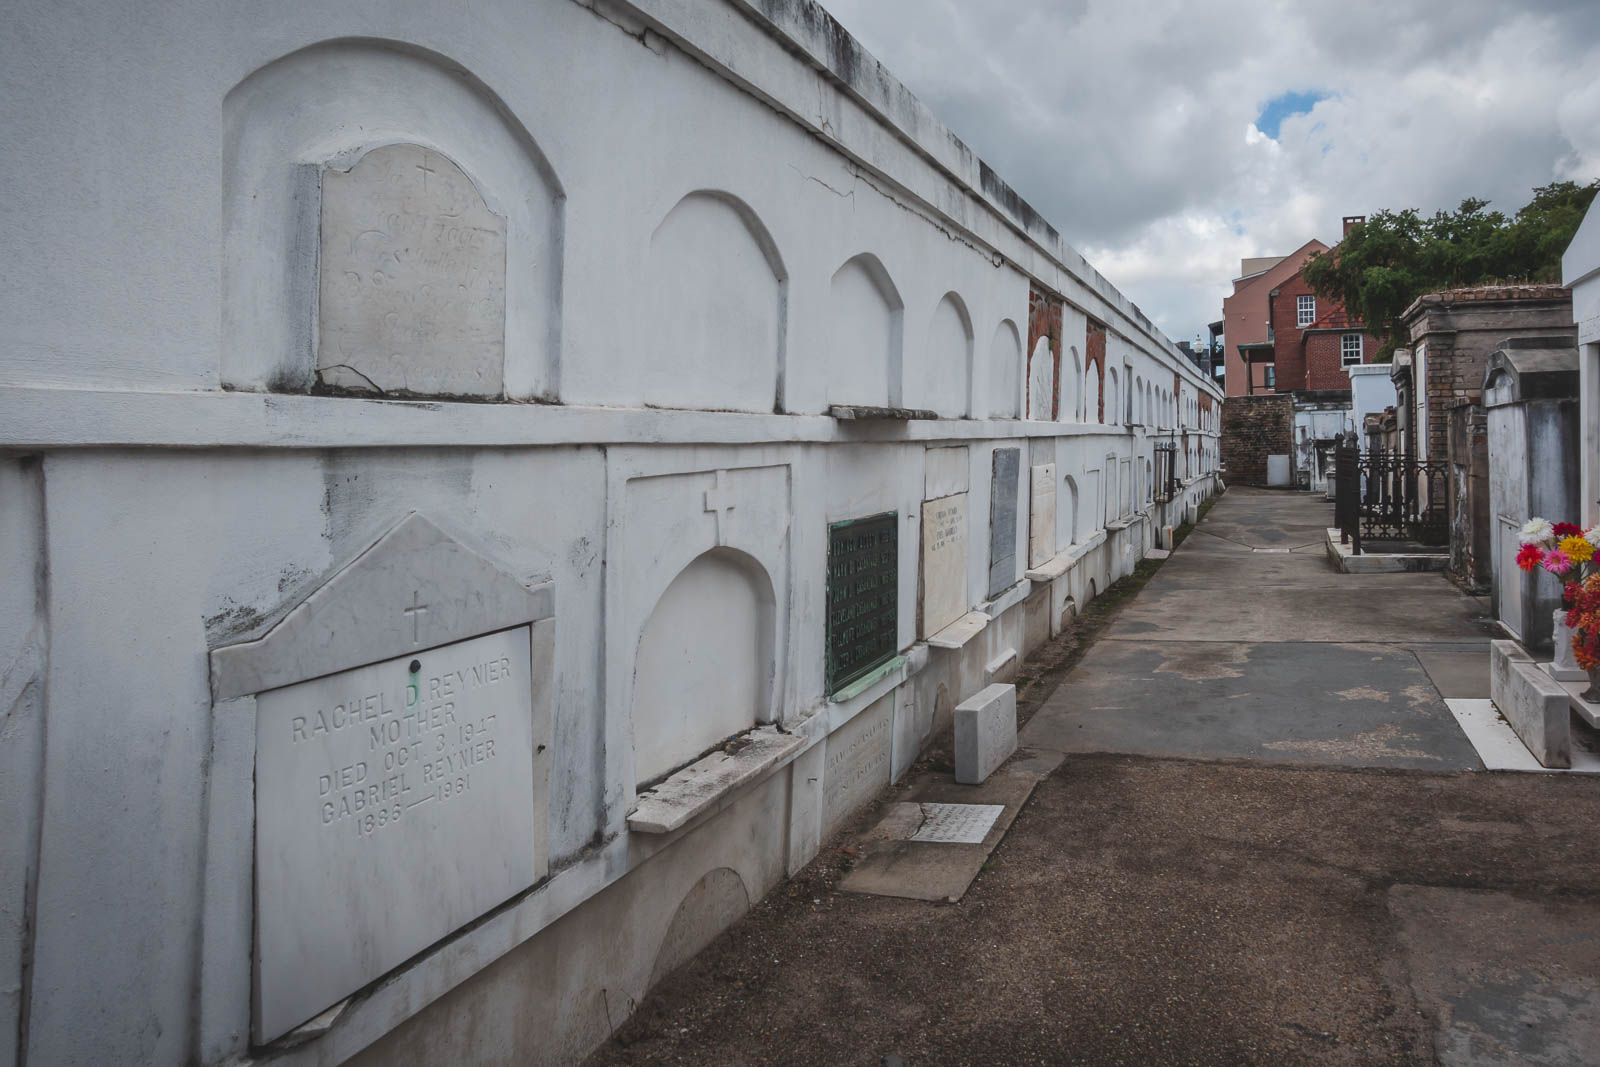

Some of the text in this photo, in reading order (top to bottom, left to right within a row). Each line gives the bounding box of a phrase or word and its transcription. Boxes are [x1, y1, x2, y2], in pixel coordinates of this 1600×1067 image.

[290, 692, 393, 743] RACHEL
[429, 657, 512, 701] REYNIER
[369, 701, 457, 750] MOTHER
[318, 761, 368, 796] DIED
[384, 740, 427, 772] OCT.
[321, 739, 496, 825] GABRIEL REYNIER
